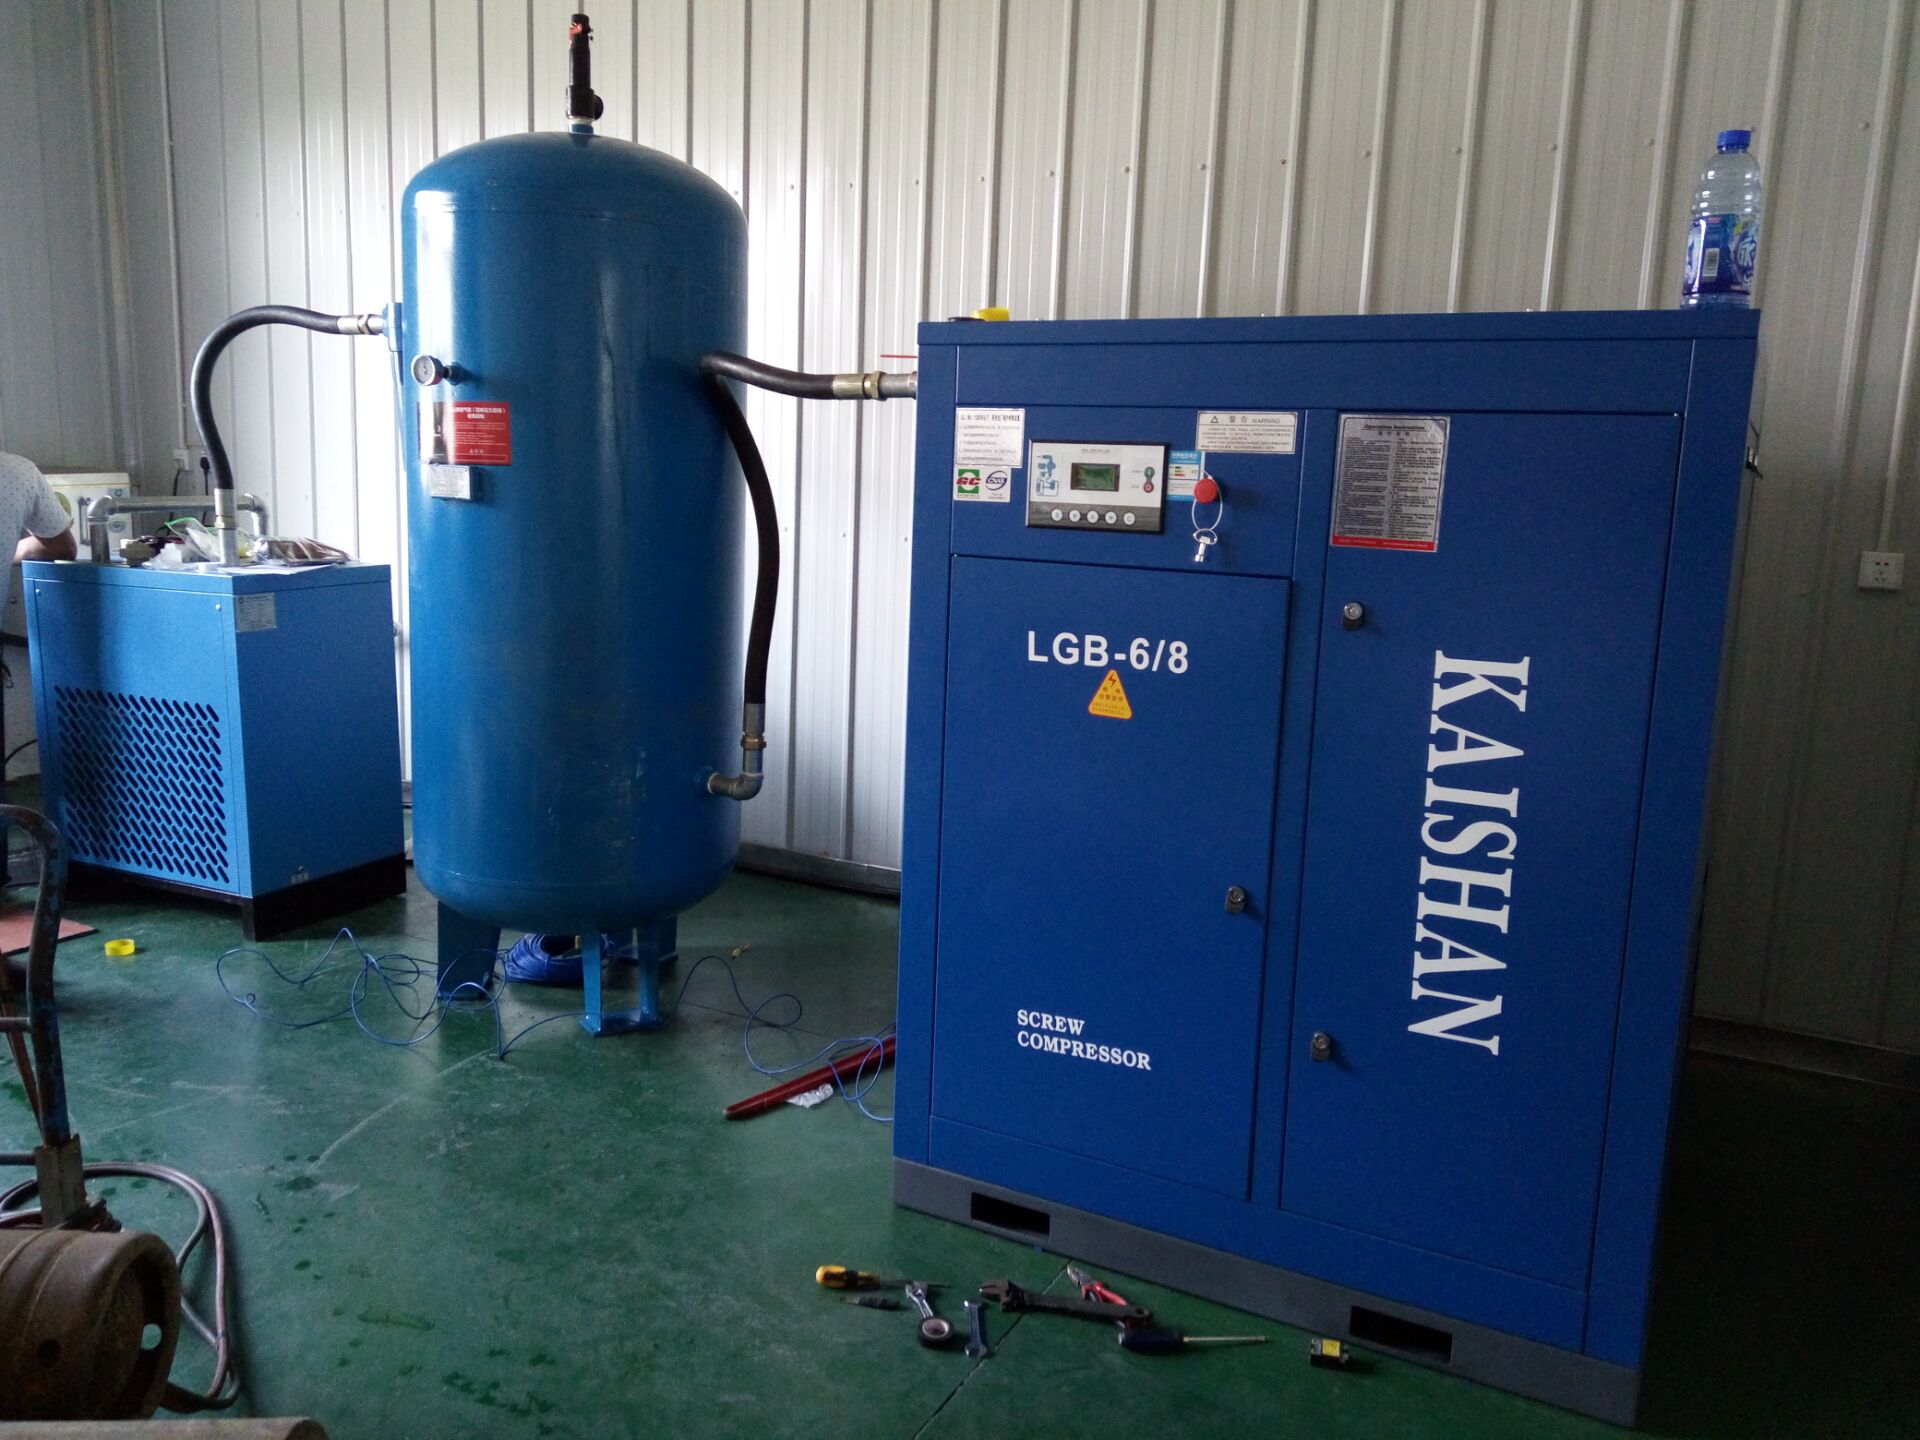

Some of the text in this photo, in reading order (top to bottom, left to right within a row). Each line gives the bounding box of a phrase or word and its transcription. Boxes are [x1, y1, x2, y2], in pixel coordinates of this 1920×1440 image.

[956, 477, 981, 486] GC
[1028, 631, 1188, 674] LGB-6/8
[1408, 650, 1530, 1056] KAISHAN
[1017, 1009, 1085, 1036] SCREW
[1017, 1031, 1151, 1071] COMPRESSOR
